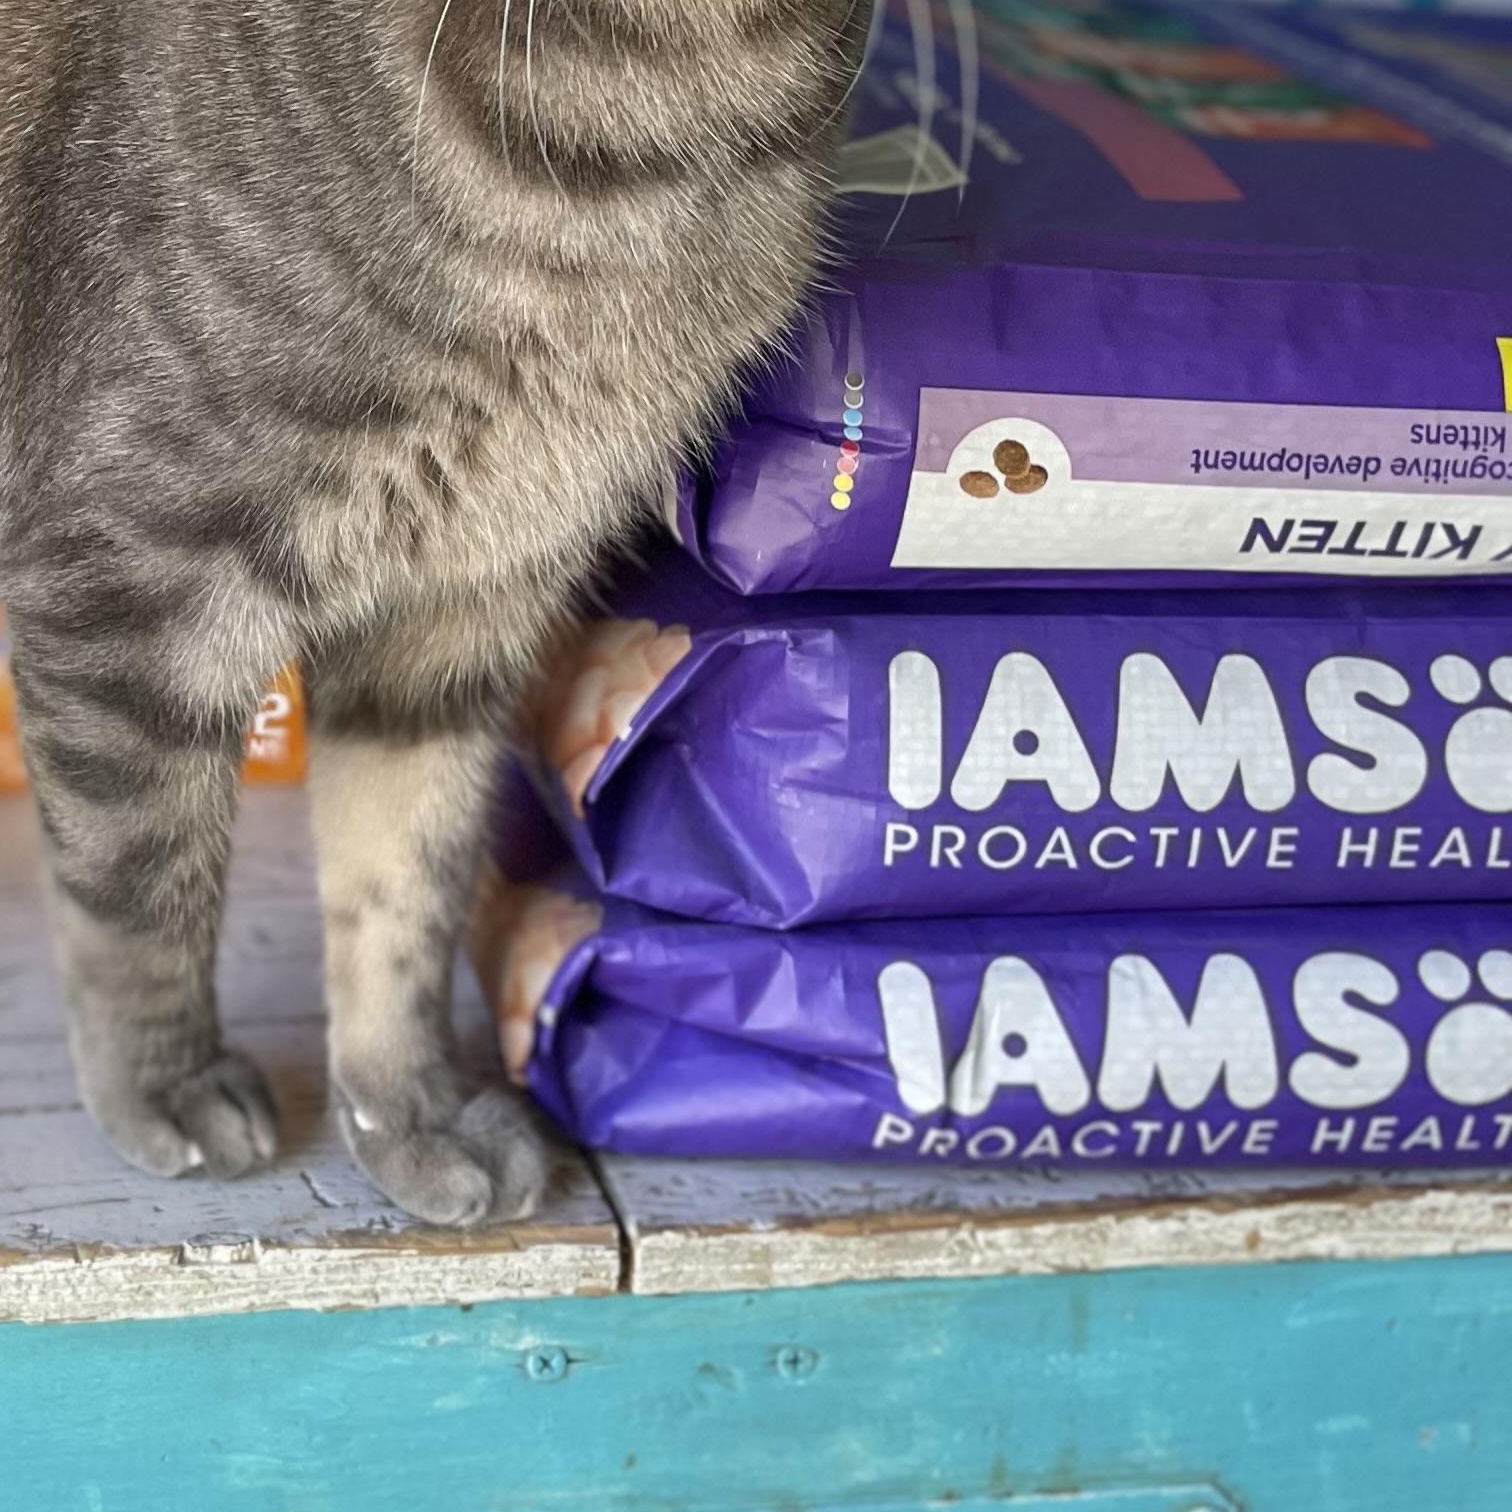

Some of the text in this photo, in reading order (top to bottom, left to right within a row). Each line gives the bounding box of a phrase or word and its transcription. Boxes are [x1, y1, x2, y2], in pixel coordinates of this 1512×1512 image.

[1410, 422, 1506, 454] kittens
[1190, 447, 1381, 482] development
[1239, 517, 1484, 561] KITTEN
[251, 692, 292, 737] 2
[888, 650, 1429, 814] IAMS
[882, 821, 1512, 870] PROACTIVE HEAL
[876, 950, 1411, 1118] IAMS
[871, 1113, 1281, 1160] PROACTIVE
